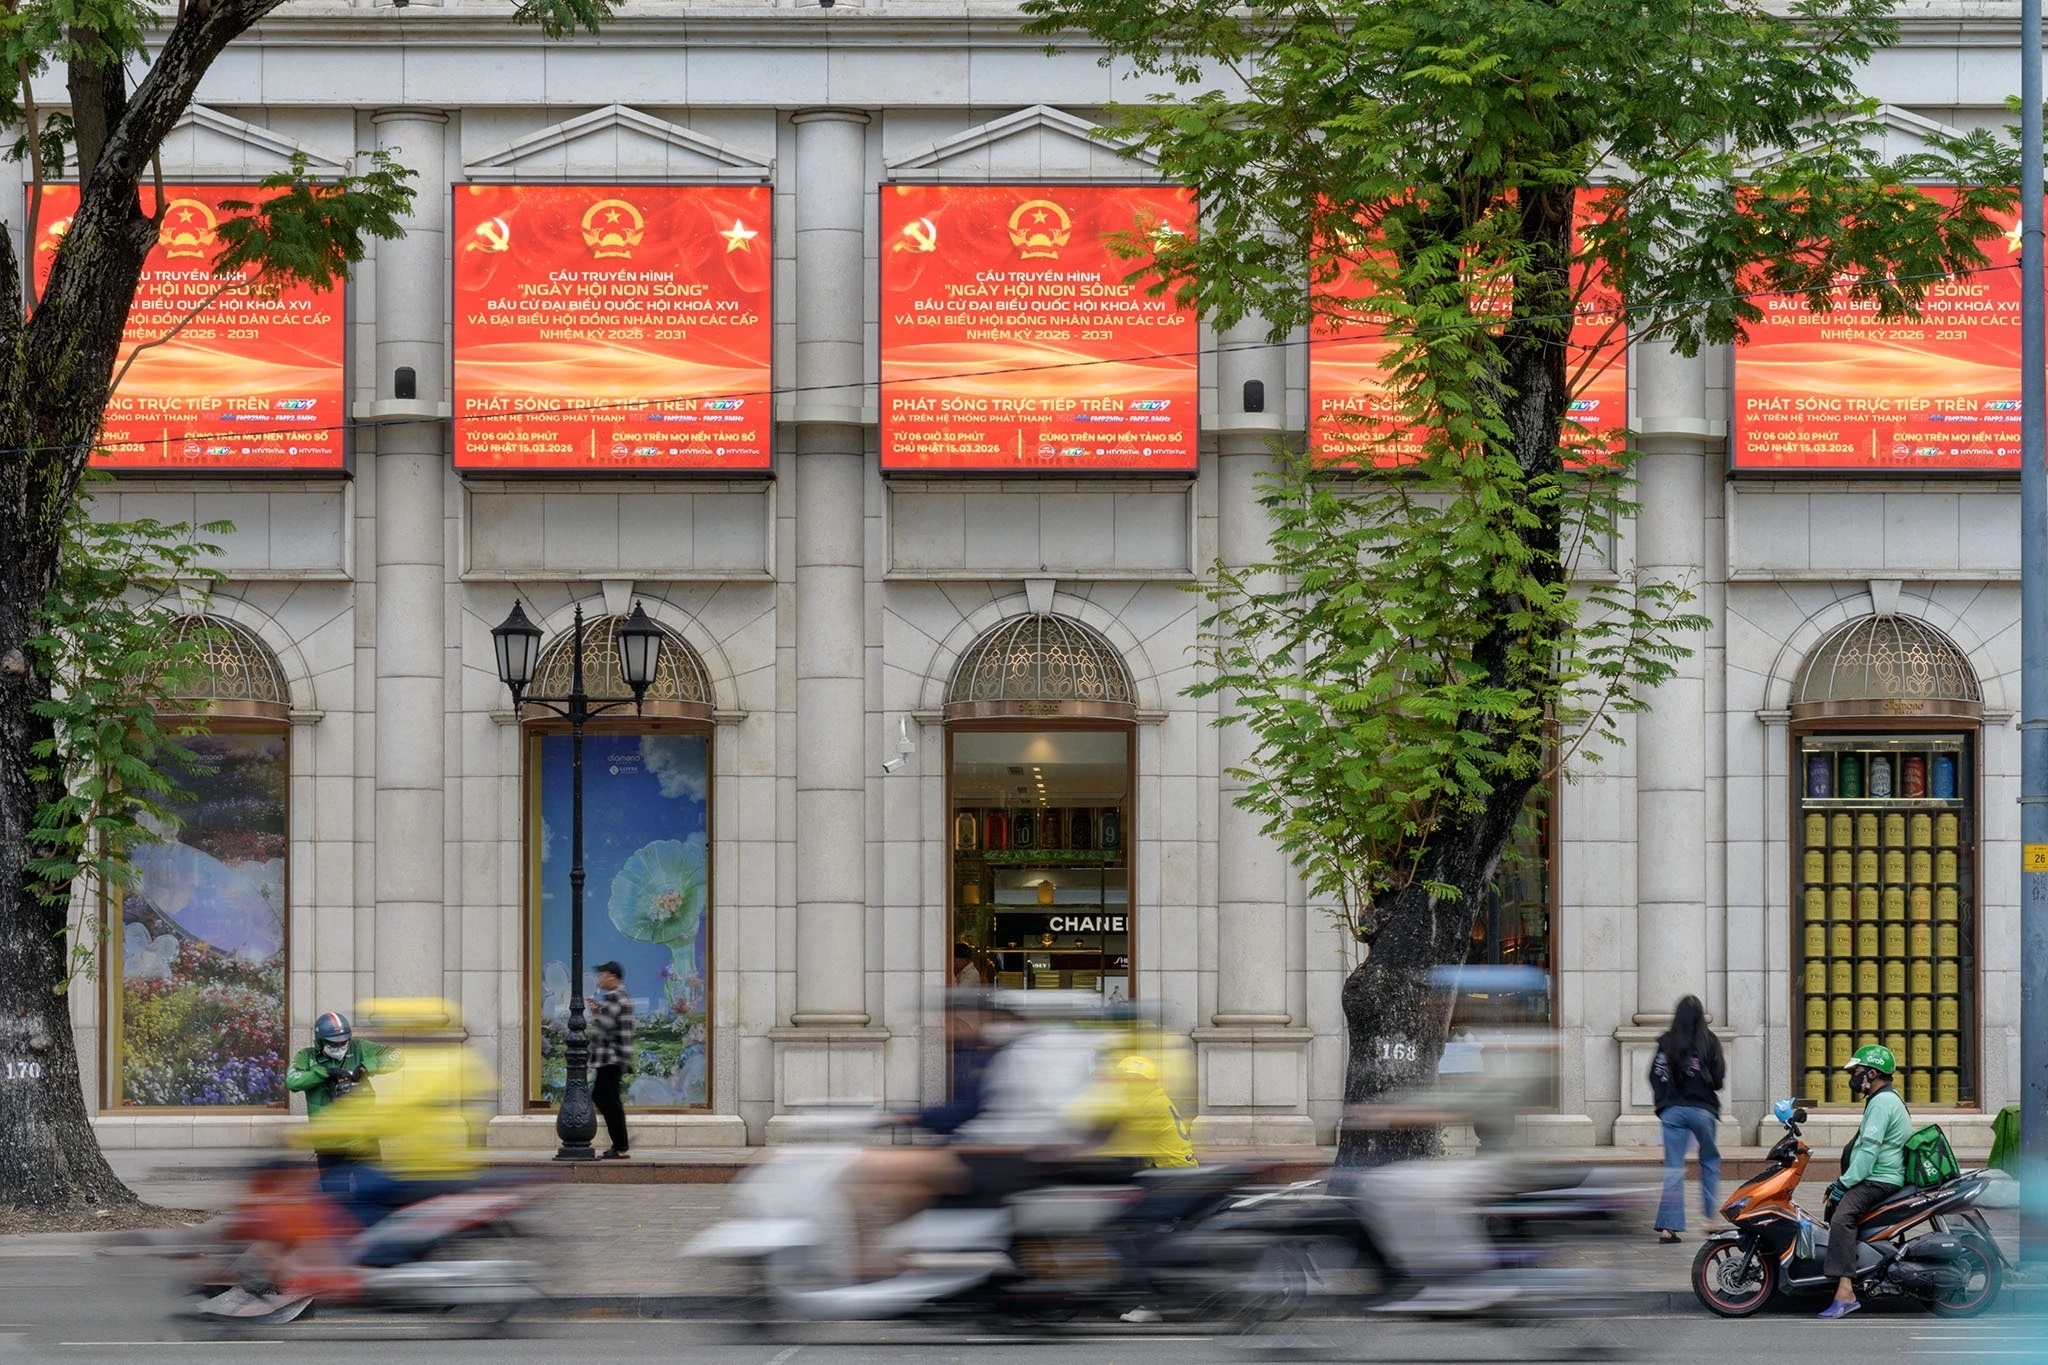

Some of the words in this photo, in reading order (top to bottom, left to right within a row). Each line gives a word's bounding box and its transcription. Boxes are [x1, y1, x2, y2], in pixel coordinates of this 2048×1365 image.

[150, 282, 179, 298] HỘI
[184, 284, 221, 296] NON
[577, 282, 606, 298] HỘI
[611, 284, 648, 296] NON
[653, 282, 708, 296] SÔNG"
[1004, 282, 1033, 298] HỘI
[1038, 284, 1075, 296] NON
[1080, 282, 1135, 296] SÔNG"
[1934, 282, 1989, 296] SÔNG"
[247, 299, 286, 310] KHOÁ
[289, 301, 311, 310] XVI
[542, 301, 565, 312] ĐẠI
[647, 300, 670, 312] HỘI
[674, 299, 713, 310] KHOÁ
[716, 301, 738, 310] XVI
[969, 301, 992, 312] ĐẠI
[1074, 300, 1097, 312] HỘI
[1101, 299, 1140, 310] KHOÁ
[1143, 301, 1165, 310] XVI
[1928, 300, 1951, 312] HỘI
[1955, 299, 1994, 310] KHOÁ
[1997, 301, 2019, 310] XVI
[273, 313, 300, 324] CÁC
[468, 312, 487, 324] VÀ
[490, 315, 514, 326] ĐẠI
[553, 314, 576, 326] HỘI
[700, 313, 727, 324] CÁC
[895, 312, 914, 324] VÀ
[917, 315, 941, 326] ĐẠI
[980, 314, 1003, 326] HỘI
[1127, 313, 1154, 324] CÁC
[1771, 315, 1795, 326] ĐẠI
[1981, 313, 2008, 324] CÁC
[181, 330, 216, 339] 2026
[228, 330, 259, 339] 2031
[608, 330, 643, 339] 2026
[655, 330, 686, 339] 2031
[1035, 330, 1070, 339] 2026
[1082, 330, 1113, 339] 2031
[1889, 330, 1924, 339] 2026
[1936, 330, 1967, 339] 2031
[274, 400, 317, 410] HTV9
[466, 396, 509, 410] PHÁT
[514, 396, 560, 411] SÓNG
[701, 400, 744, 410] HTV9
[893, 396, 936, 410] PHÁT
[941, 396, 987, 411] SÓNG
[1128, 400, 1171, 410] HTV9
[1747, 396, 1790, 410] PHÁT
[1795, 396, 1841, 411] SÓNG
[1016, 826, 1030, 843] 10
[1105, 826, 1115, 843] 9
[2034, 854, 2046, 863] 26
[1382, 1043, 1417, 1061] 168
[1867, 1056, 1885, 1065] Grab
[6, 1062, 42, 1079] 170
